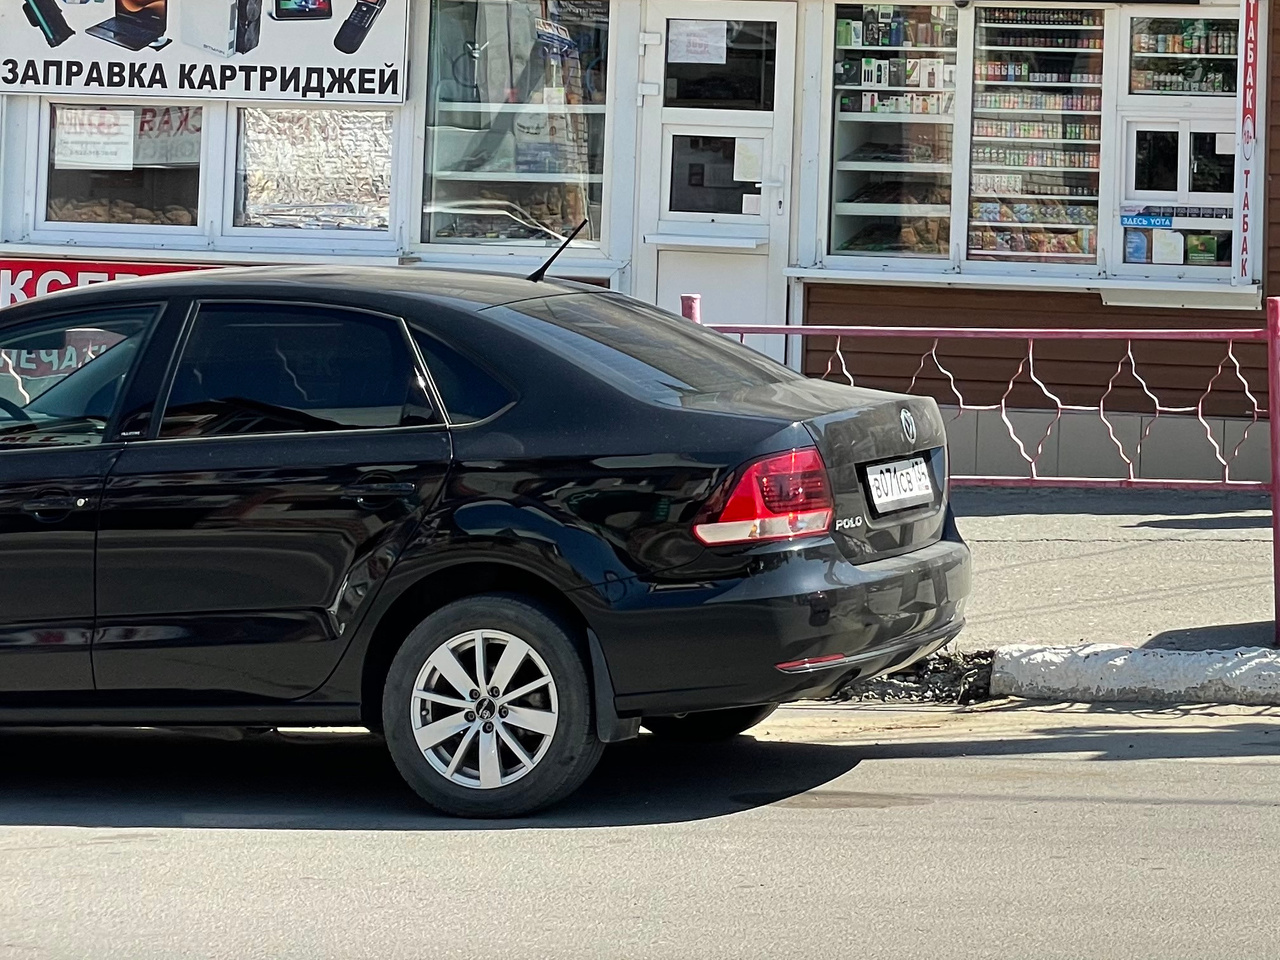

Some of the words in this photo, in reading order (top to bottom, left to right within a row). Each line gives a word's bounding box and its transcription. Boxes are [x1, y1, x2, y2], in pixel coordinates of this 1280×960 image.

[1, 58, 168, 89] ЗАПРАВКА
[178, 63, 399, 98] КАРТРИДЖЕЙ
[1122, 217, 1148, 225] ЗДЕСЬ
[1150, 218, 1171, 226] YOTA
[1240, 170, 1250, 277] ТАБАК
[835, 516, 862, 531] POLO
